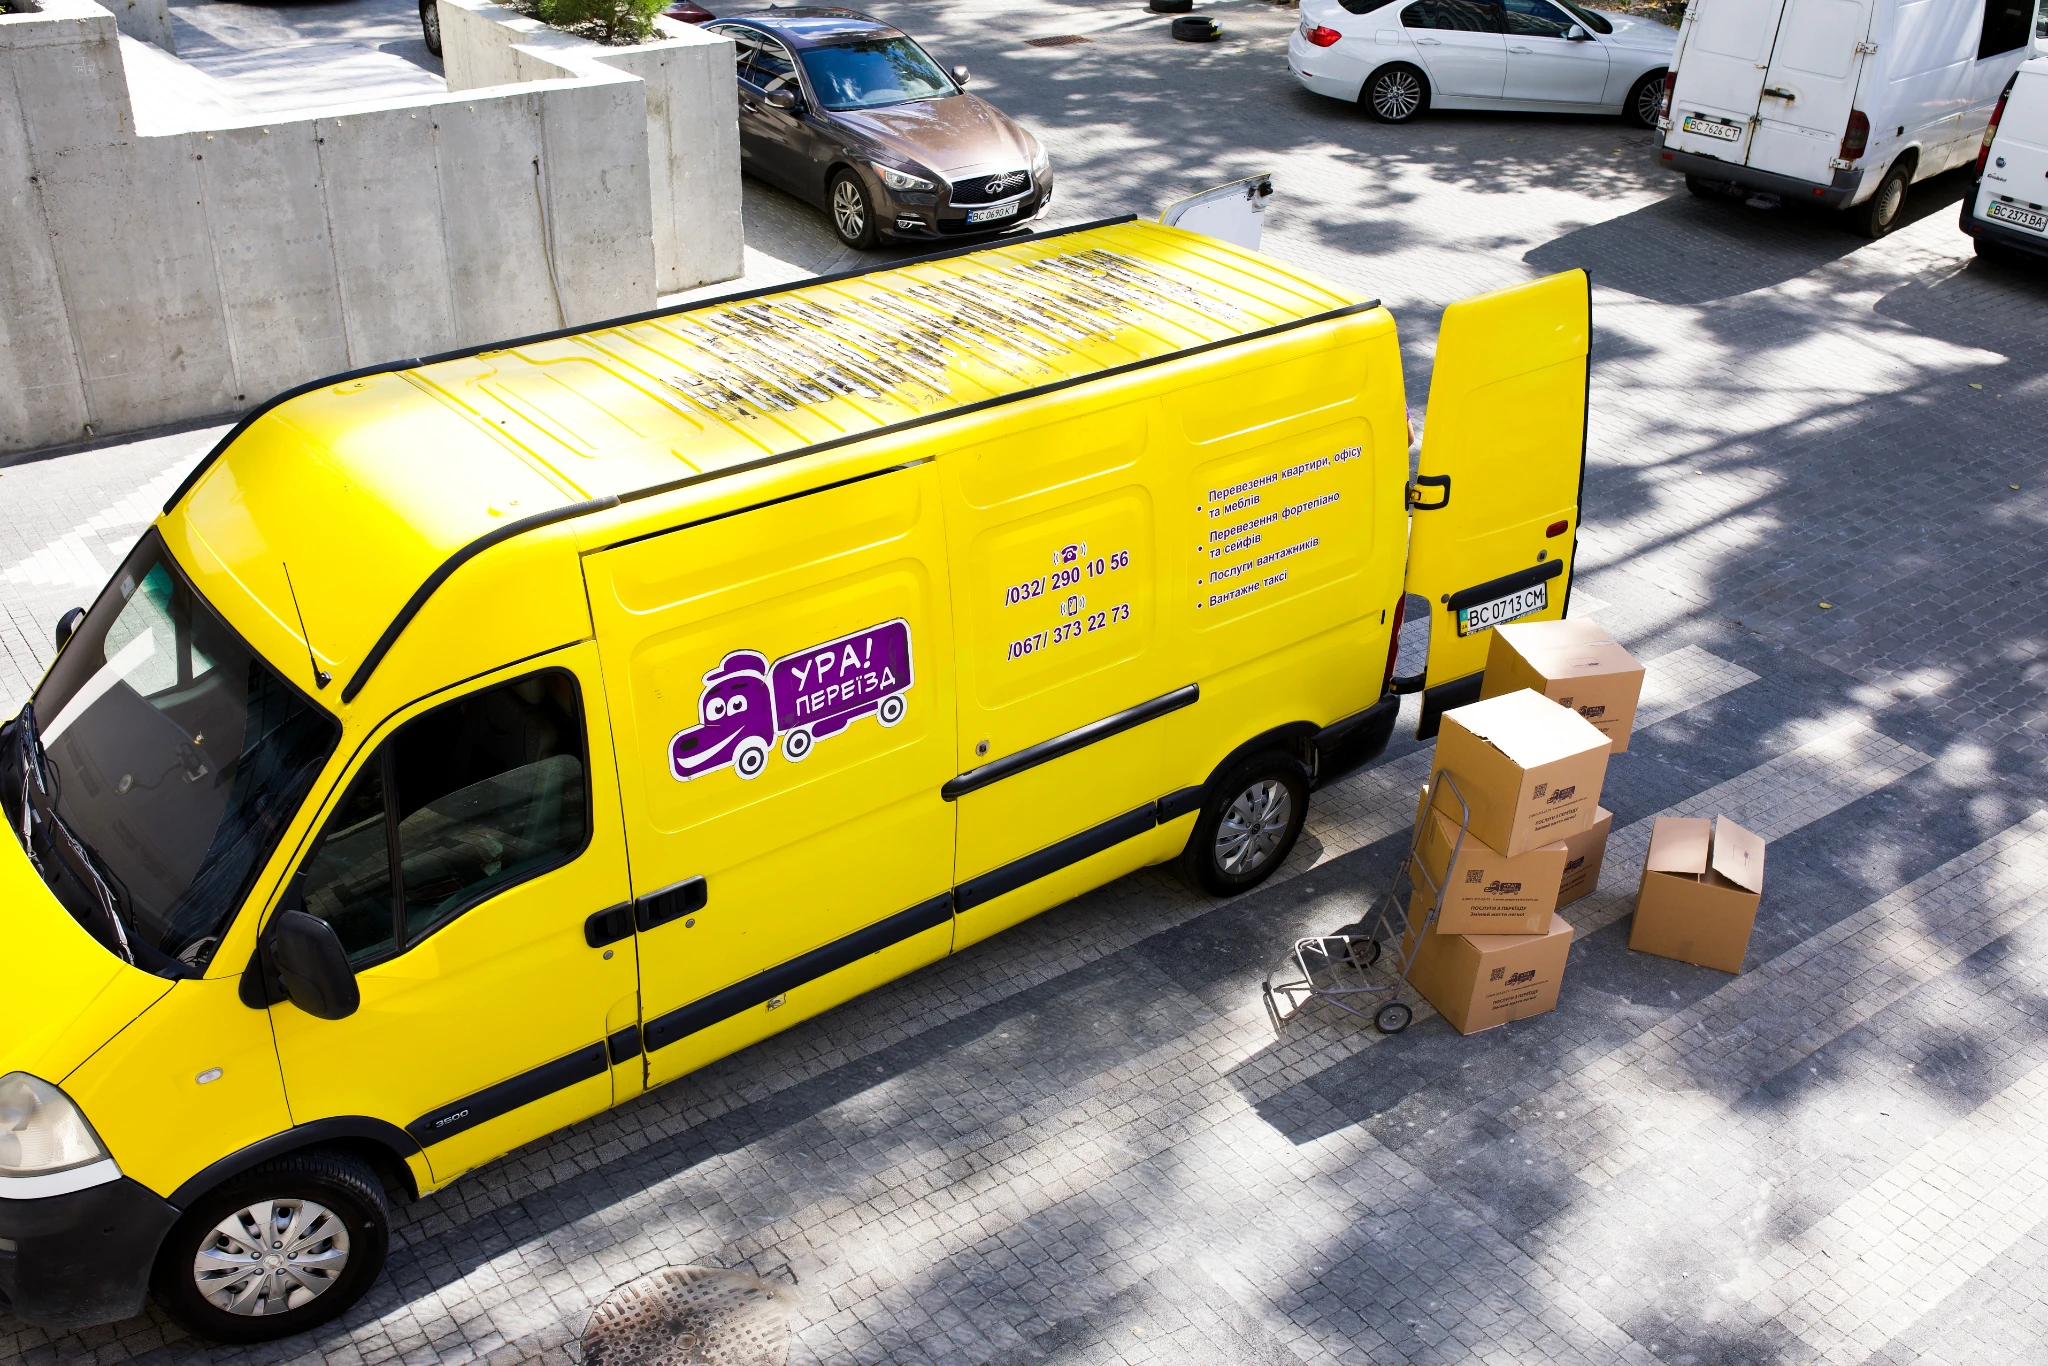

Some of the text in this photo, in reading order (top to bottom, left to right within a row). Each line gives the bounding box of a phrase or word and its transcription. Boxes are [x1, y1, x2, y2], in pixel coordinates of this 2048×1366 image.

[1689, 120, 1739, 138] BC 7626 CT
[973, 204, 1016, 221] BC 0690 KT
[1993, 205, 2043, 228] BC 2373 BA
[1208, 445, 1363, 502] Перевезення квартири, офісу
[1208, 493, 1261, 519] та меблів
[1209, 491, 1341, 543] Перевезення фортепіано
[1209, 533, 1261, 559] та сейфів
[1209, 537, 1319, 583] Послуги вантажників
[1005, 550, 1129, 607] /032/ 290 10 56
[1208, 569, 1288, 608] Вантажне таксі
[1469, 606, 1490, 628] BC
[1492, 595, 1522, 620] 0713
[1525, 587, 1543, 608] CM
[1007, 603, 1130, 661] /067/ 373 22 73
[791, 638, 873, 692] УРА!
[796, 666, 896, 717] ПЕРЕЇЗД
[435, 1109, 469, 1128] 3500
